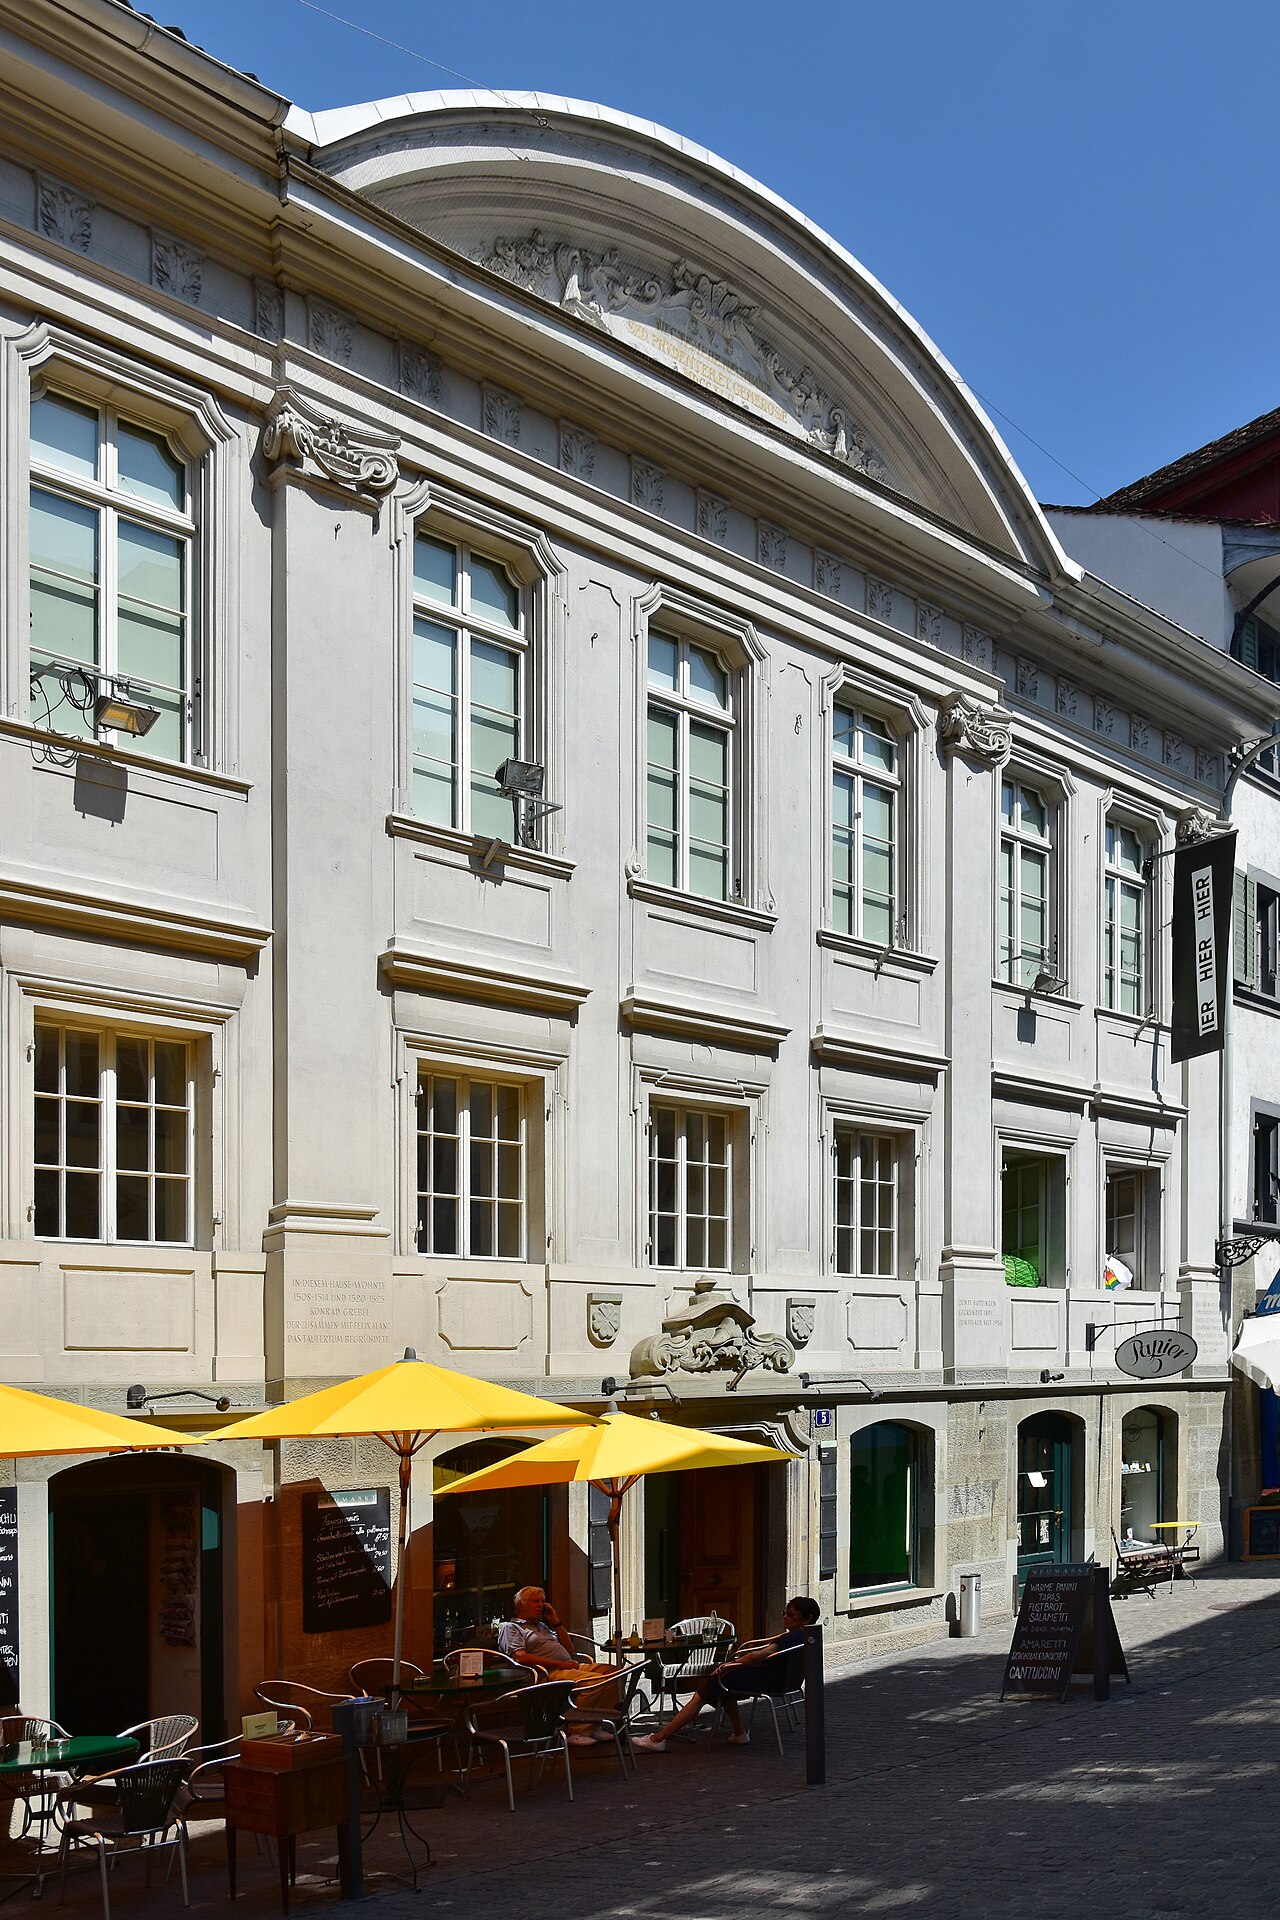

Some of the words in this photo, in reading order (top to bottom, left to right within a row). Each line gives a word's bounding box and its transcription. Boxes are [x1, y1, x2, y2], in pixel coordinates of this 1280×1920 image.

[1195, 875, 1211, 921] HIER
[1198, 937, 1213, 982] HIER
[310, 1307, 340, 1316] KONRAD
[342, 1308, 370, 1317] GREBEL
[1125, 1339, 1189, 1373] Papier
[320, 1494, 376, 1504] NEUMARKT
[1030, 1582, 1053, 1592] WARME
[1055, 1582, 1078, 1592] PANINI
[1038, 1592, 1061, 1602] TAPAS
[1020, 1640, 1067, 1649] AMARETTI
[1009, 1666, 1061, 1681] CANTUCCINI
